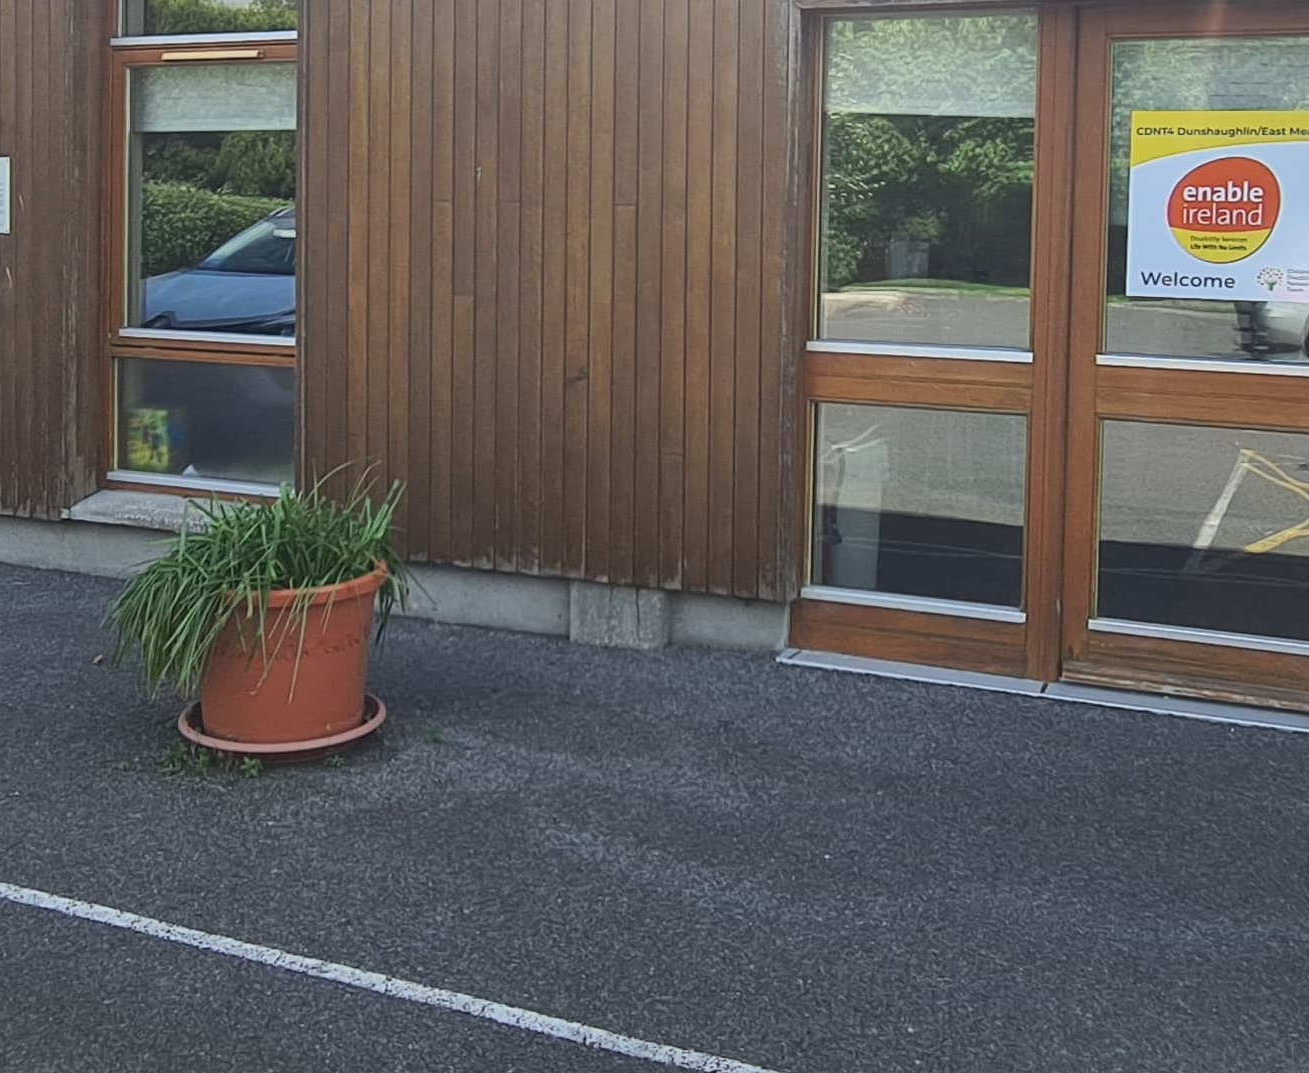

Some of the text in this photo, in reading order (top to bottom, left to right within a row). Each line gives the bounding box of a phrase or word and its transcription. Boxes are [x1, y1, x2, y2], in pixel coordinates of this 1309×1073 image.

[1136, 127, 1174, 136] CDNT4
[1177, 126, 1286, 138] Dunshaughlin/East
[1182, 180, 1264, 202] enable
[1182, 203, 1263, 225] ireland
[1140, 271, 1236, 288] Welcome
